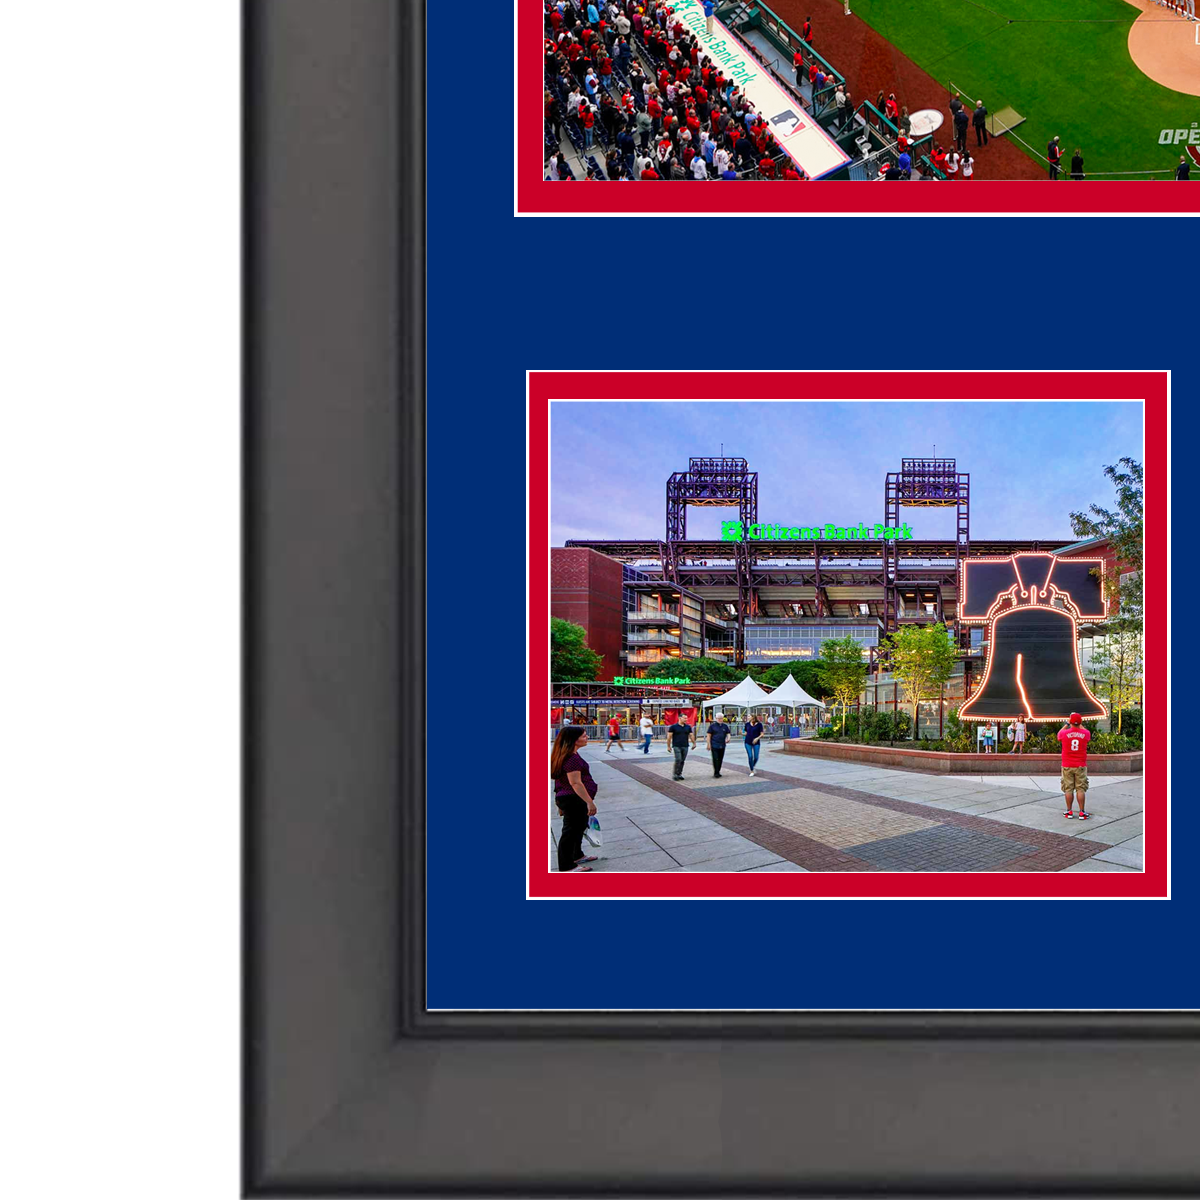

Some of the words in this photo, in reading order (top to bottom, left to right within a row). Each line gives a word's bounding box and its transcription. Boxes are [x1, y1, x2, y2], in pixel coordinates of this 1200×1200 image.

[682, 11, 717, 45] Citizens
[708, 39, 738, 67] Bank
[728, 60, 758, 87] Park
[749, 523, 821, 540] Citizens
[824, 522, 869, 540] Bank
[873, 522, 914, 540] Park
[624, 677, 655, 685] Citizens
[655, 677, 674, 685] Bank
[674, 677, 691, 685] Park
[1070, 739, 1080, 751] 8
